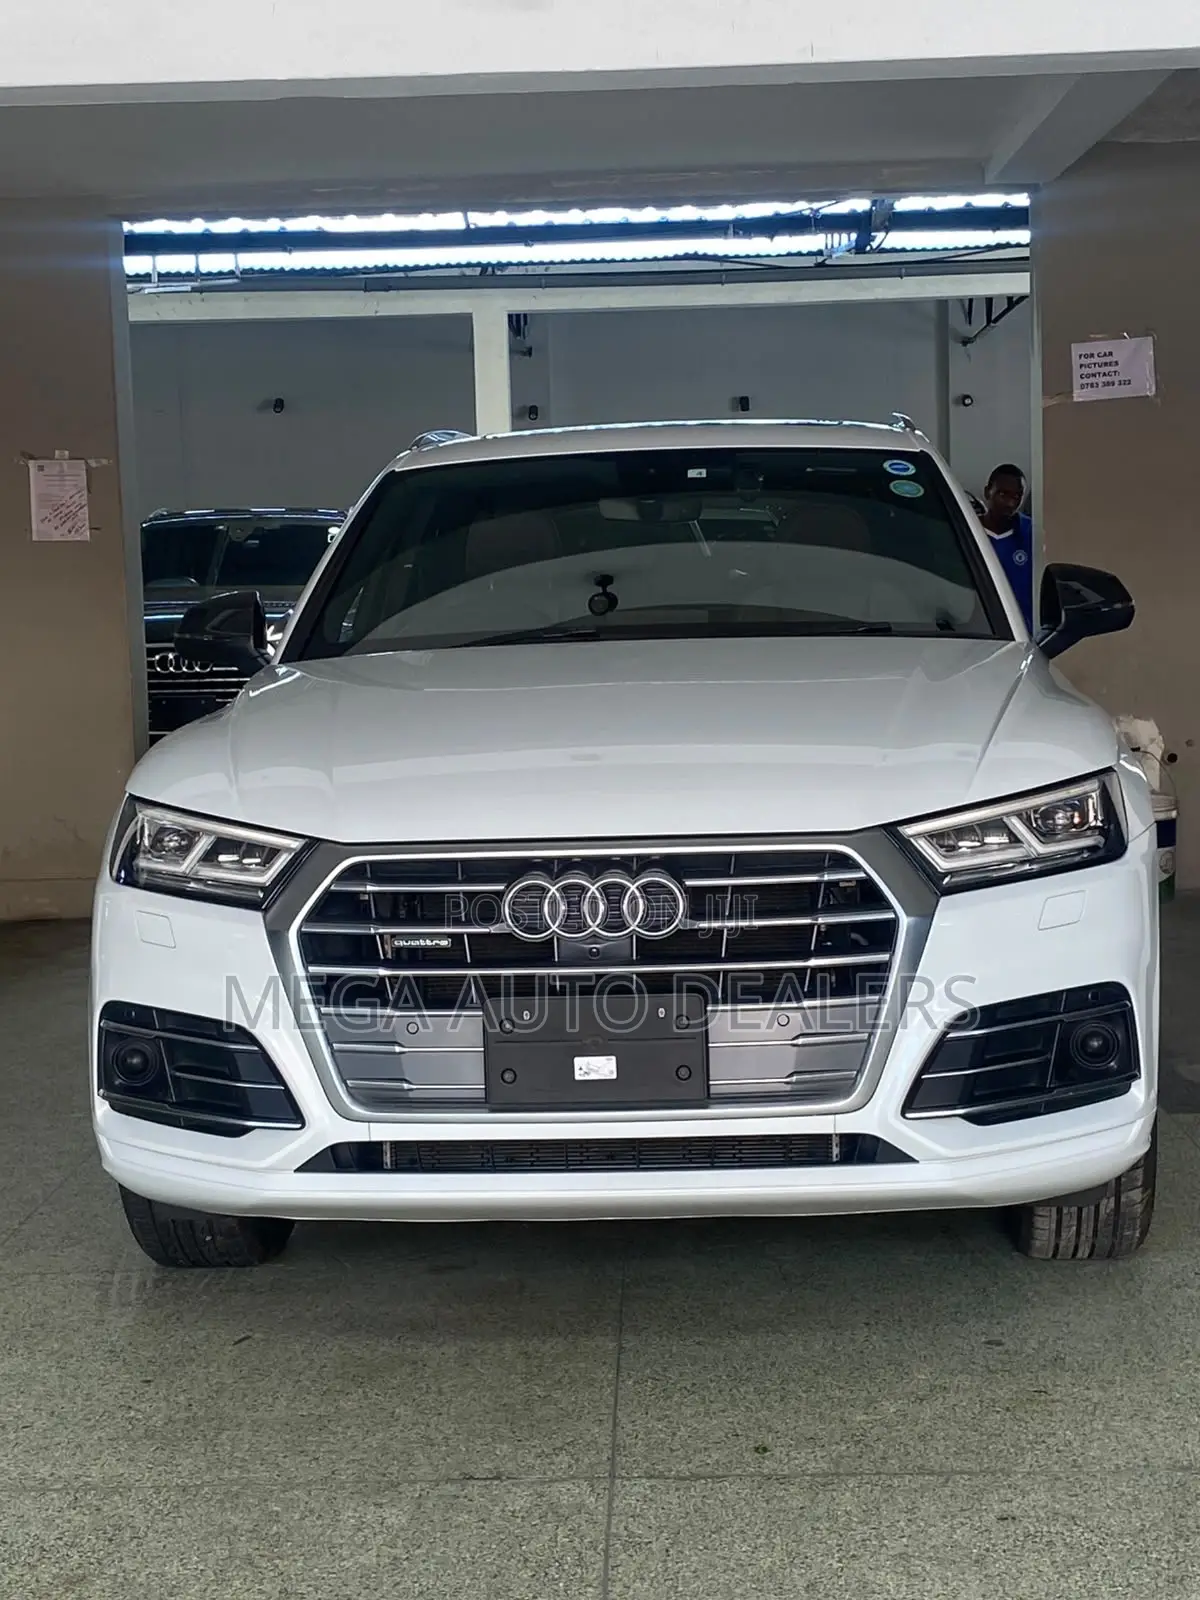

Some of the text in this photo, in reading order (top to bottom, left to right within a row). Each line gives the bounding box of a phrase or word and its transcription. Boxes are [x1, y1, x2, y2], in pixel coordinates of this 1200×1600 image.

[1079, 352, 1095, 360] FOR
[1079, 360, 1119, 369] PICTURES
[393, 938, 449, 948] quattro
